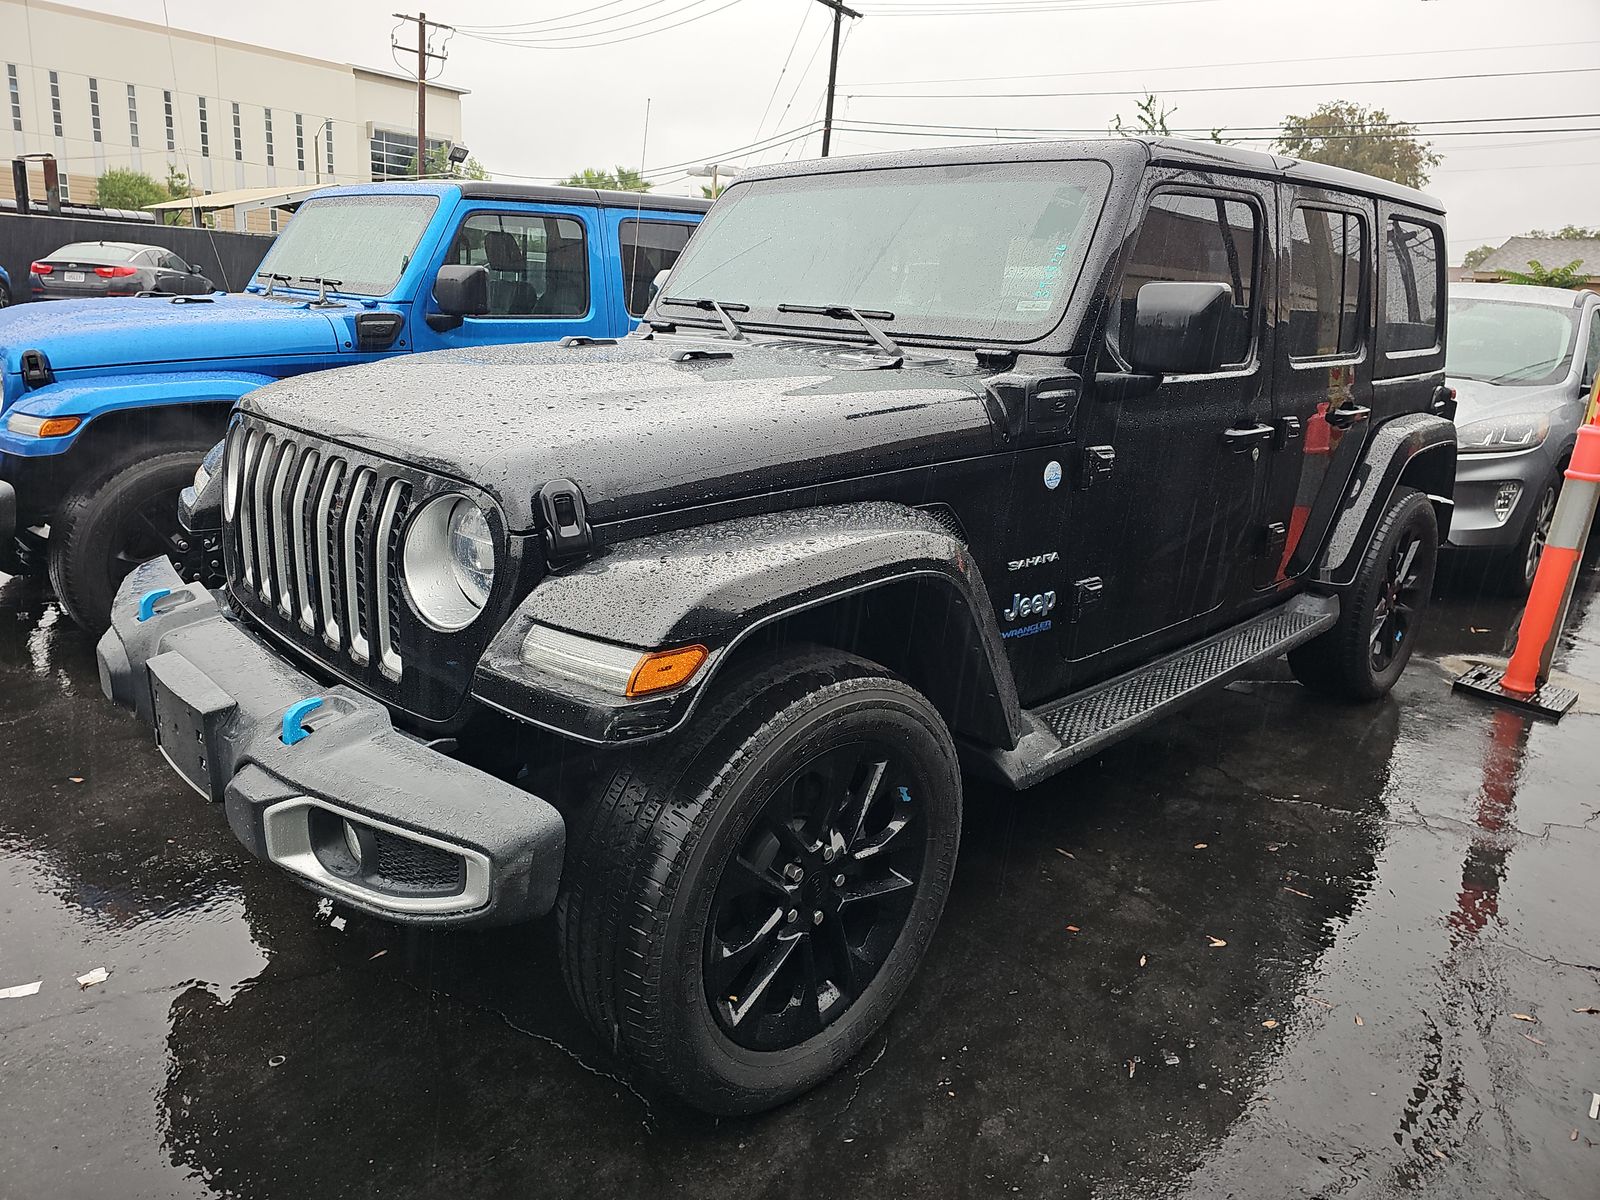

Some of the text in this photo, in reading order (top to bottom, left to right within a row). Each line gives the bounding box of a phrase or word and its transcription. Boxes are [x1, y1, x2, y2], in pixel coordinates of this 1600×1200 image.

[1007, 551, 1060, 571] SAHARA
[1003, 590, 1057, 621] Jeep
[1001, 620, 1052, 639] WRANGLER
